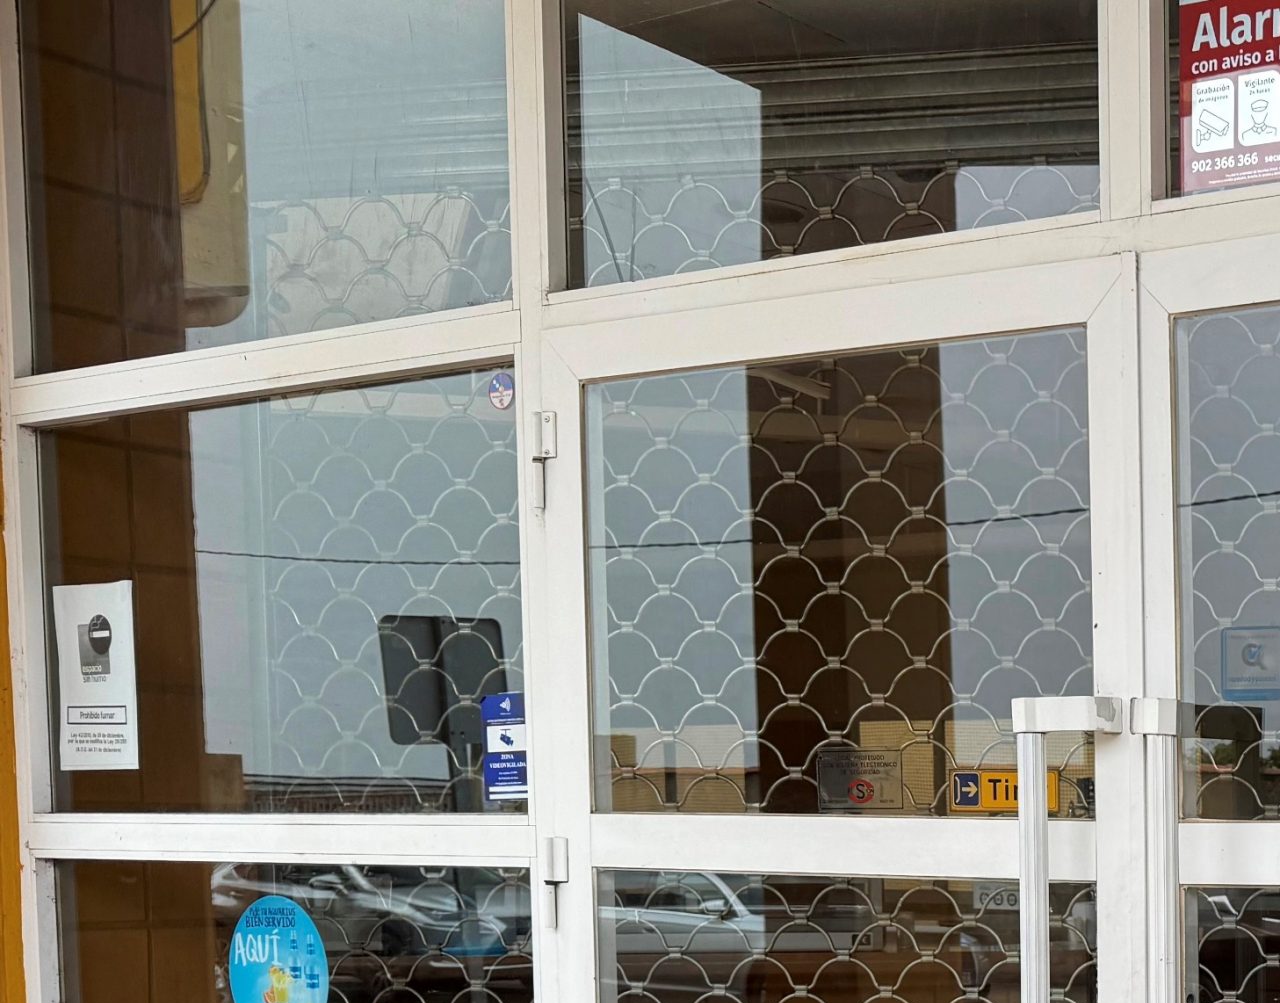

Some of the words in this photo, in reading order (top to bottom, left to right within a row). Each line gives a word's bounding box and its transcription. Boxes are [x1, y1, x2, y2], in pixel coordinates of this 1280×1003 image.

[1191, 58, 1218, 74] con
[1222, 49, 1261, 70] aviso
[1265, 50, 1274, 62] a
[1196, 84, 1230, 95] Grabación
[1244, 76, 1275, 88] Vigilante
[1191, 159, 1212, 173] 902
[1214, 156, 1235, 170] 366
[1237, 152, 1259, 167] 366
[246, 917, 264, 928] BIEN
[265, 917, 296, 928] SERVIDO
[234, 929, 283, 968] AQUÍ
